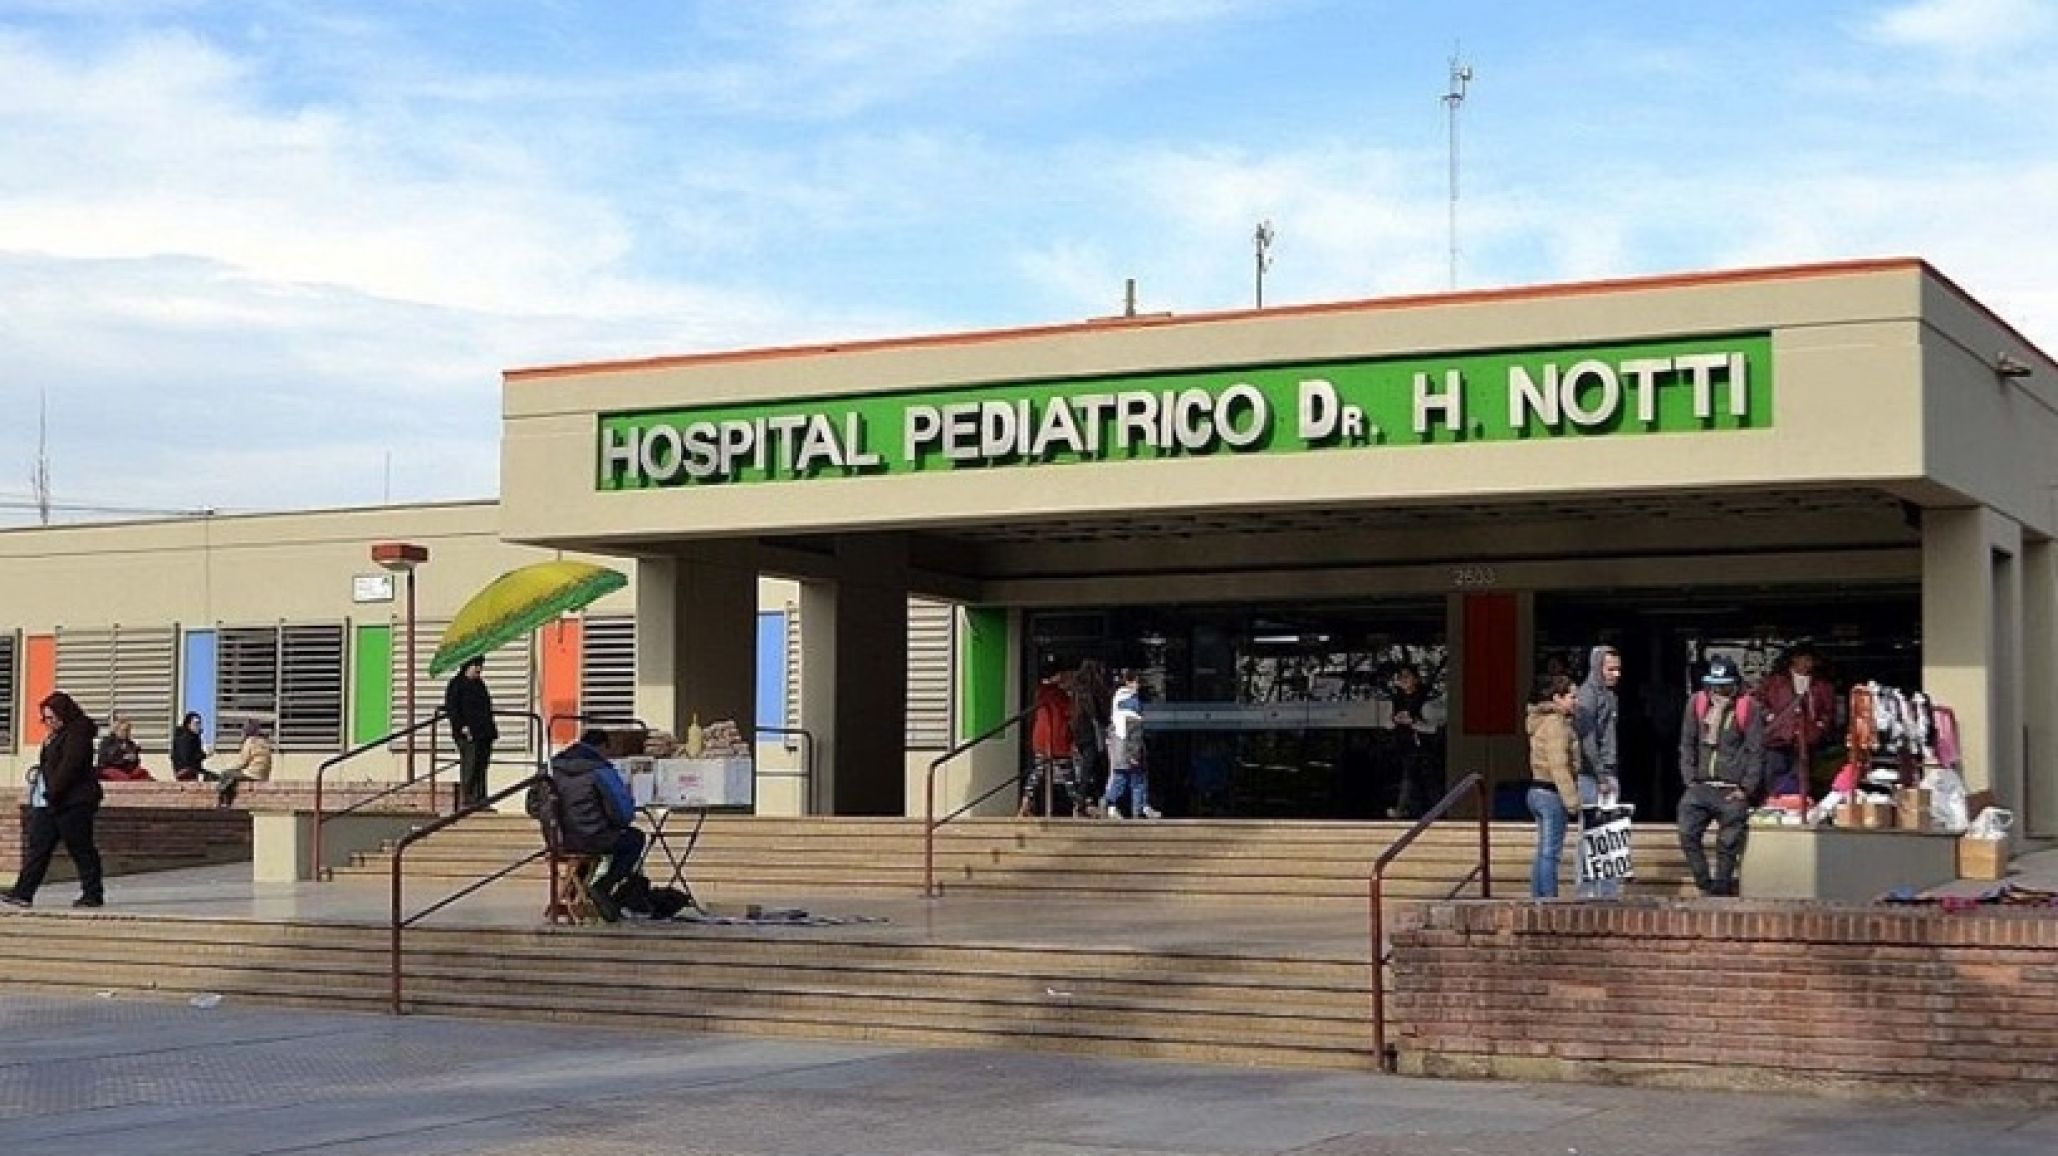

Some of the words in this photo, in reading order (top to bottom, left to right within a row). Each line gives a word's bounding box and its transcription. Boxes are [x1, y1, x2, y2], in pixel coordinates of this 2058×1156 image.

[602, 411, 879, 481] HOSPITAL
[904, 384, 1268, 464] PEDIATRICO
[1509, 351, 1748, 426] NOTTI
